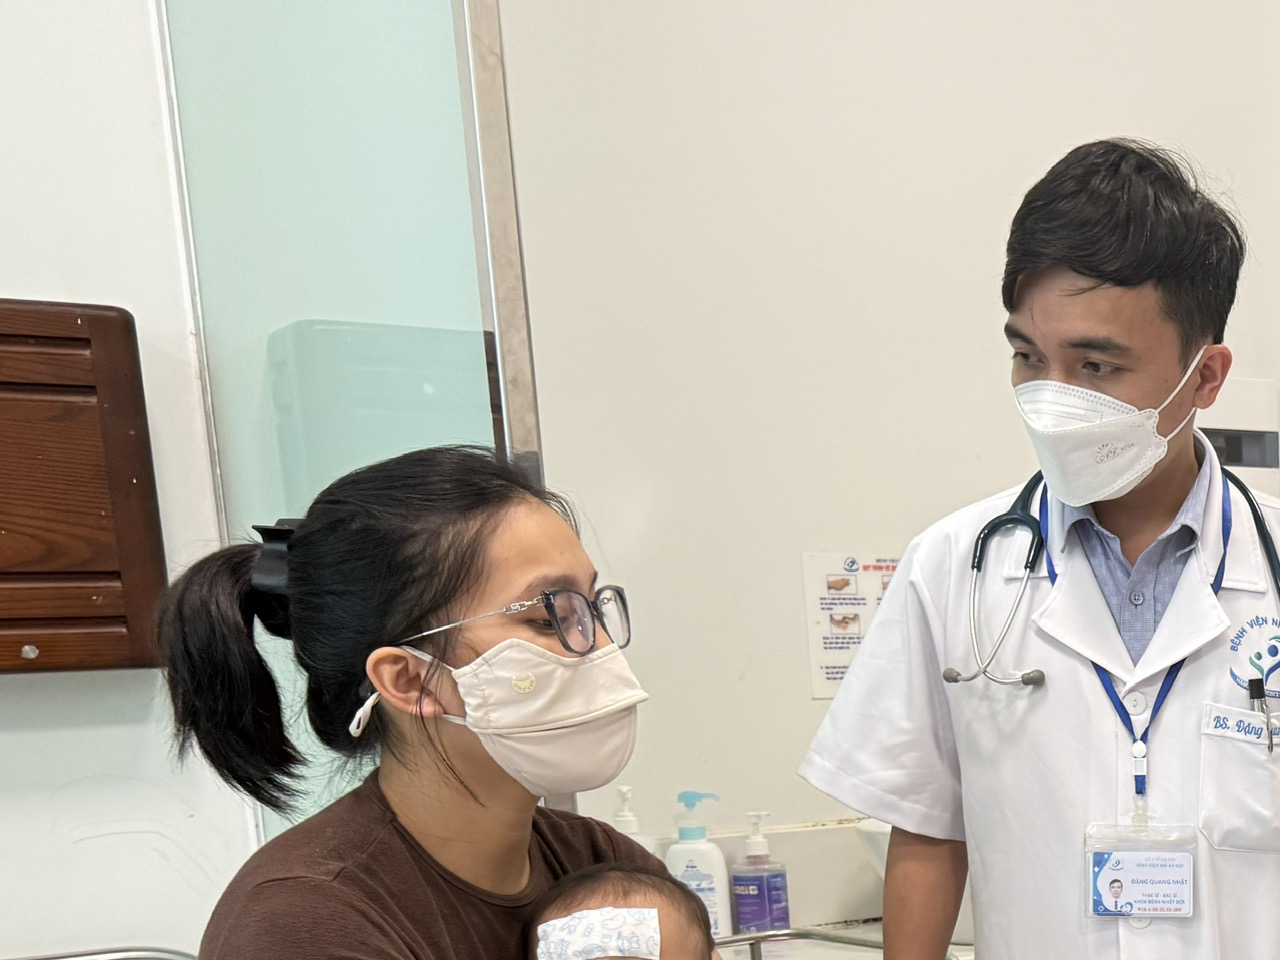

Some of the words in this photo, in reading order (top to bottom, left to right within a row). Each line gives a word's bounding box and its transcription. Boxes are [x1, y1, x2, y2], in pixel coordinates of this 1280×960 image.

[1230, 626, 1248, 652] BỆNH
[1247, 615, 1268, 629] VIỆN
[1213, 715, 1230, 730] BS.
